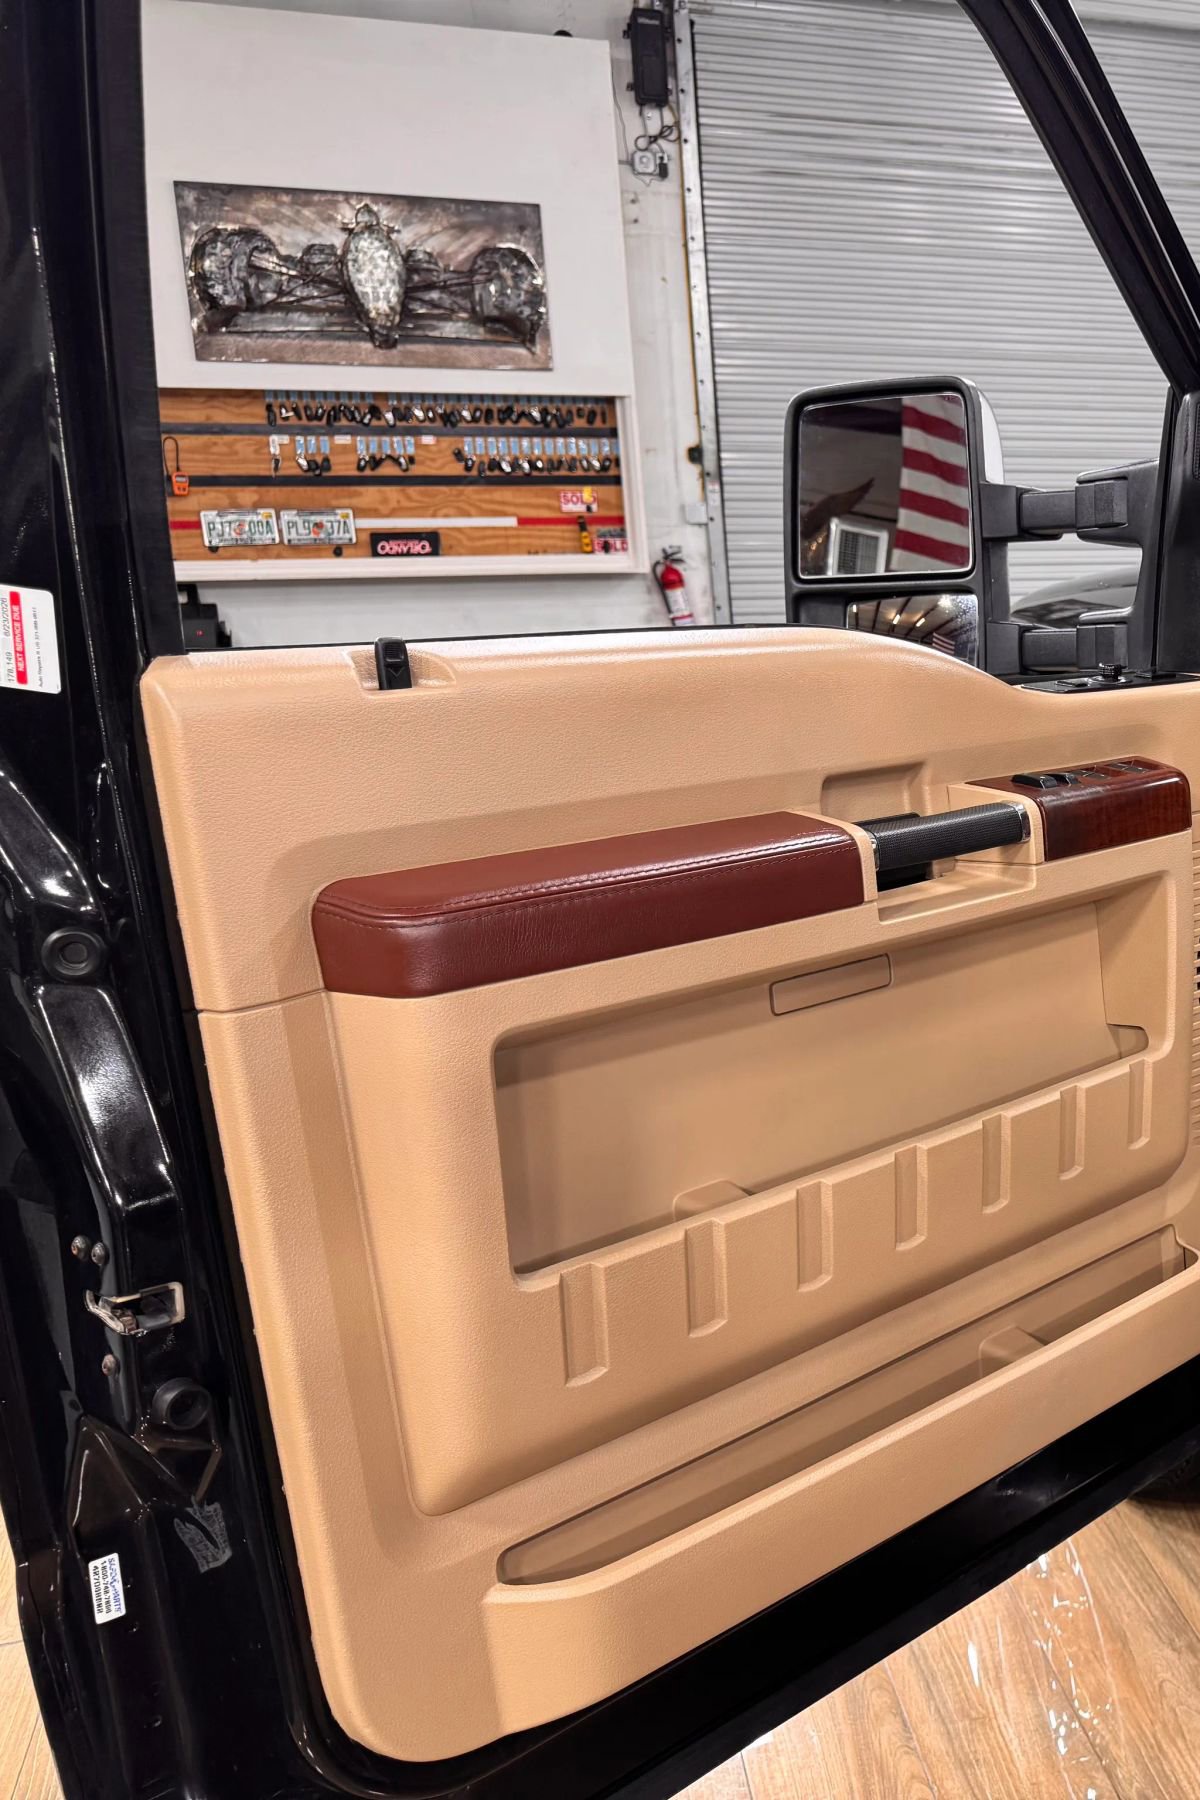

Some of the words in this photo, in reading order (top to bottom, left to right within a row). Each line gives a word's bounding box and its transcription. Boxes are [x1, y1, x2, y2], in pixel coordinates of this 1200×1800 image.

[377, 540, 432, 555] ORLANDO
[11, 605, 21, 621] DUE
[12, 621, 24, 652] SERVICE
[14, 652, 25, 672] NEXT
